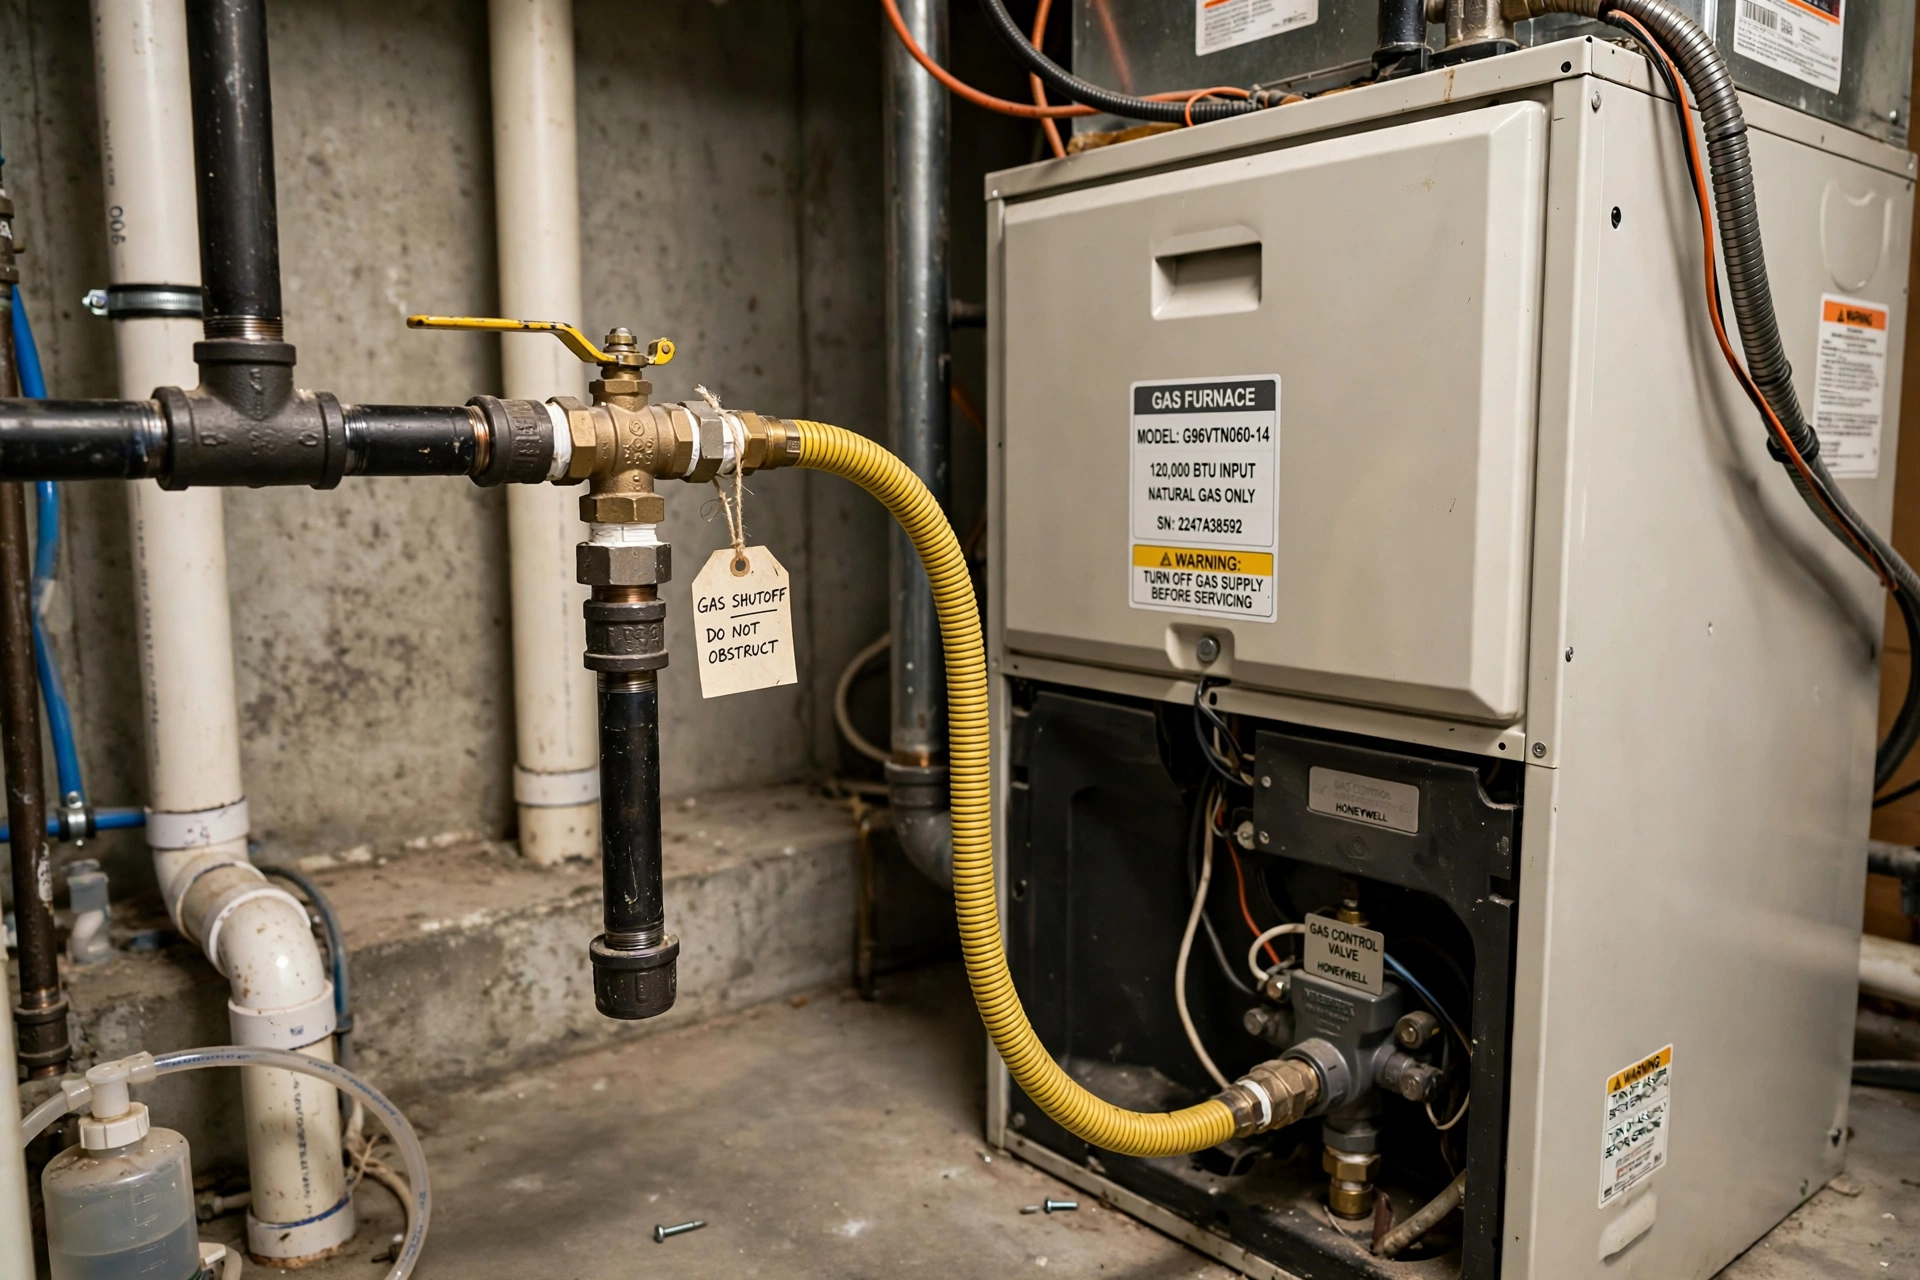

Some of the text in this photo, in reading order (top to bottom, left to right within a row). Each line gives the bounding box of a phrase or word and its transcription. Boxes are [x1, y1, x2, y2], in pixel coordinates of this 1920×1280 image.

[1152, 387, 1256, 409] GAS FURNACE
[1137, 426, 1270, 444] MODEL: G96VTN060-14
[1150, 462, 1256, 479] 120,000 BTU INPUT
[1148, 487, 1256, 503] NATURAL GAS ONLY
[1157, 515, 1243, 534] SN: 2247A38592
[1175, 552, 1242, 572] WARNING:
[1143, 570, 1264, 592] TURN OFF GAS SUPPLY
[697, 586, 787, 614] GAS SHUTOFF
[1151, 587, 1253, 609] BEFORE SERVICING
[706, 621, 760, 643] DO NOT
[708, 639, 779, 664] OBSTRUCT
[1336, 803, 1388, 823] HONEYWELL
[1309, 923, 1379, 953] GAS CONTROL
[1328, 942, 1359, 962] VALVE
[1317, 961, 1369, 985] HONEYWELL
